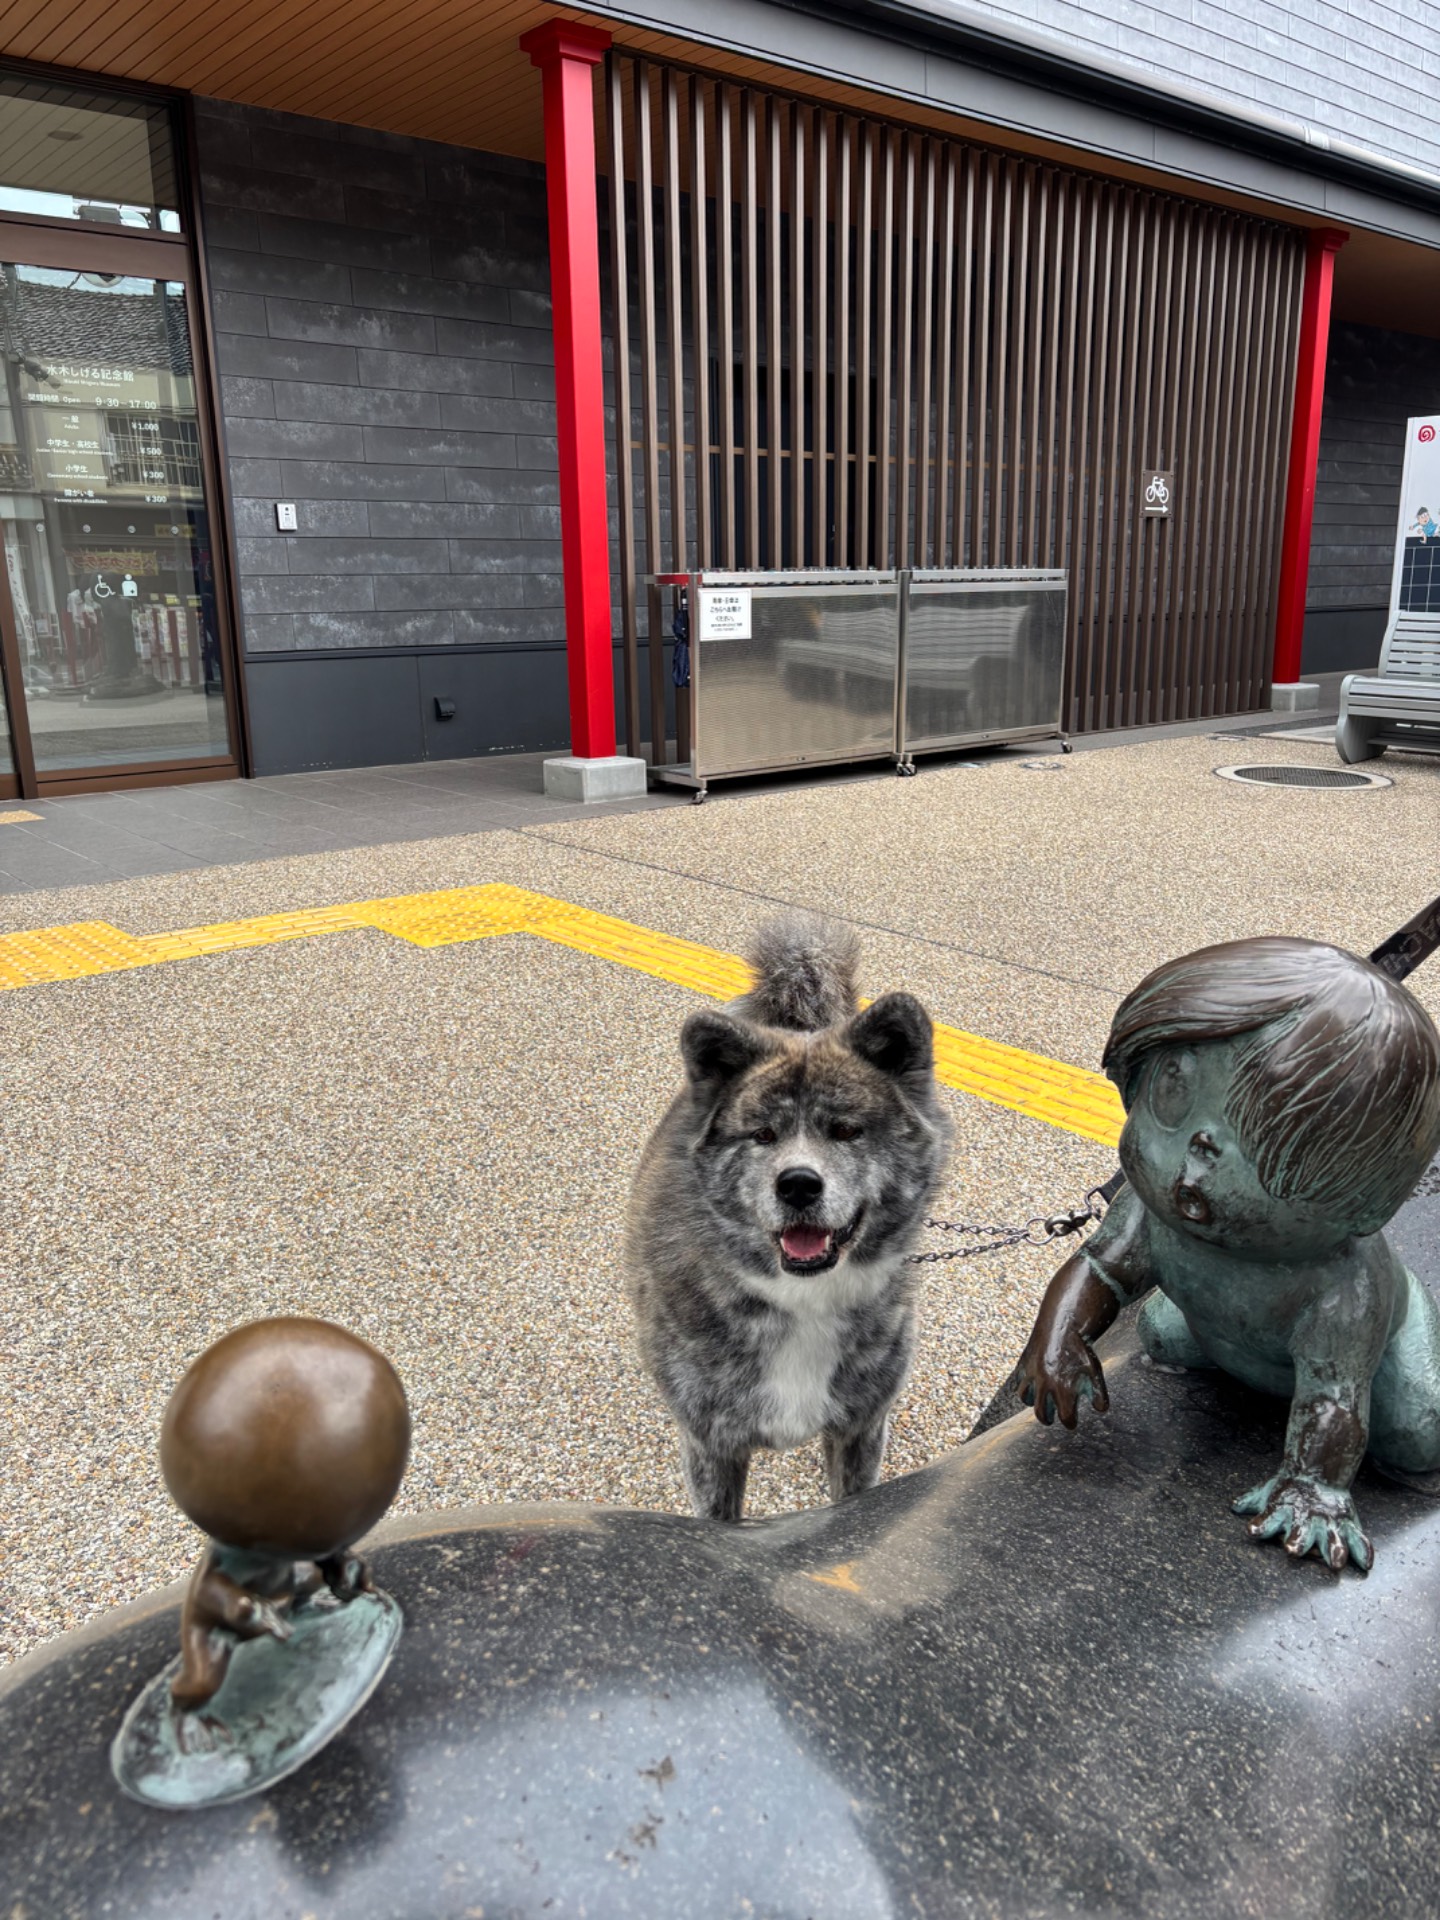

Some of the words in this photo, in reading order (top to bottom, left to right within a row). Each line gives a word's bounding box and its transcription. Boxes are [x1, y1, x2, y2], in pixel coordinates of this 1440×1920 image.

[47, 364, 134, 382] 水木しげる記念館
[63, 396, 81, 404] Open
[65, 464, 88, 473] 小学生
